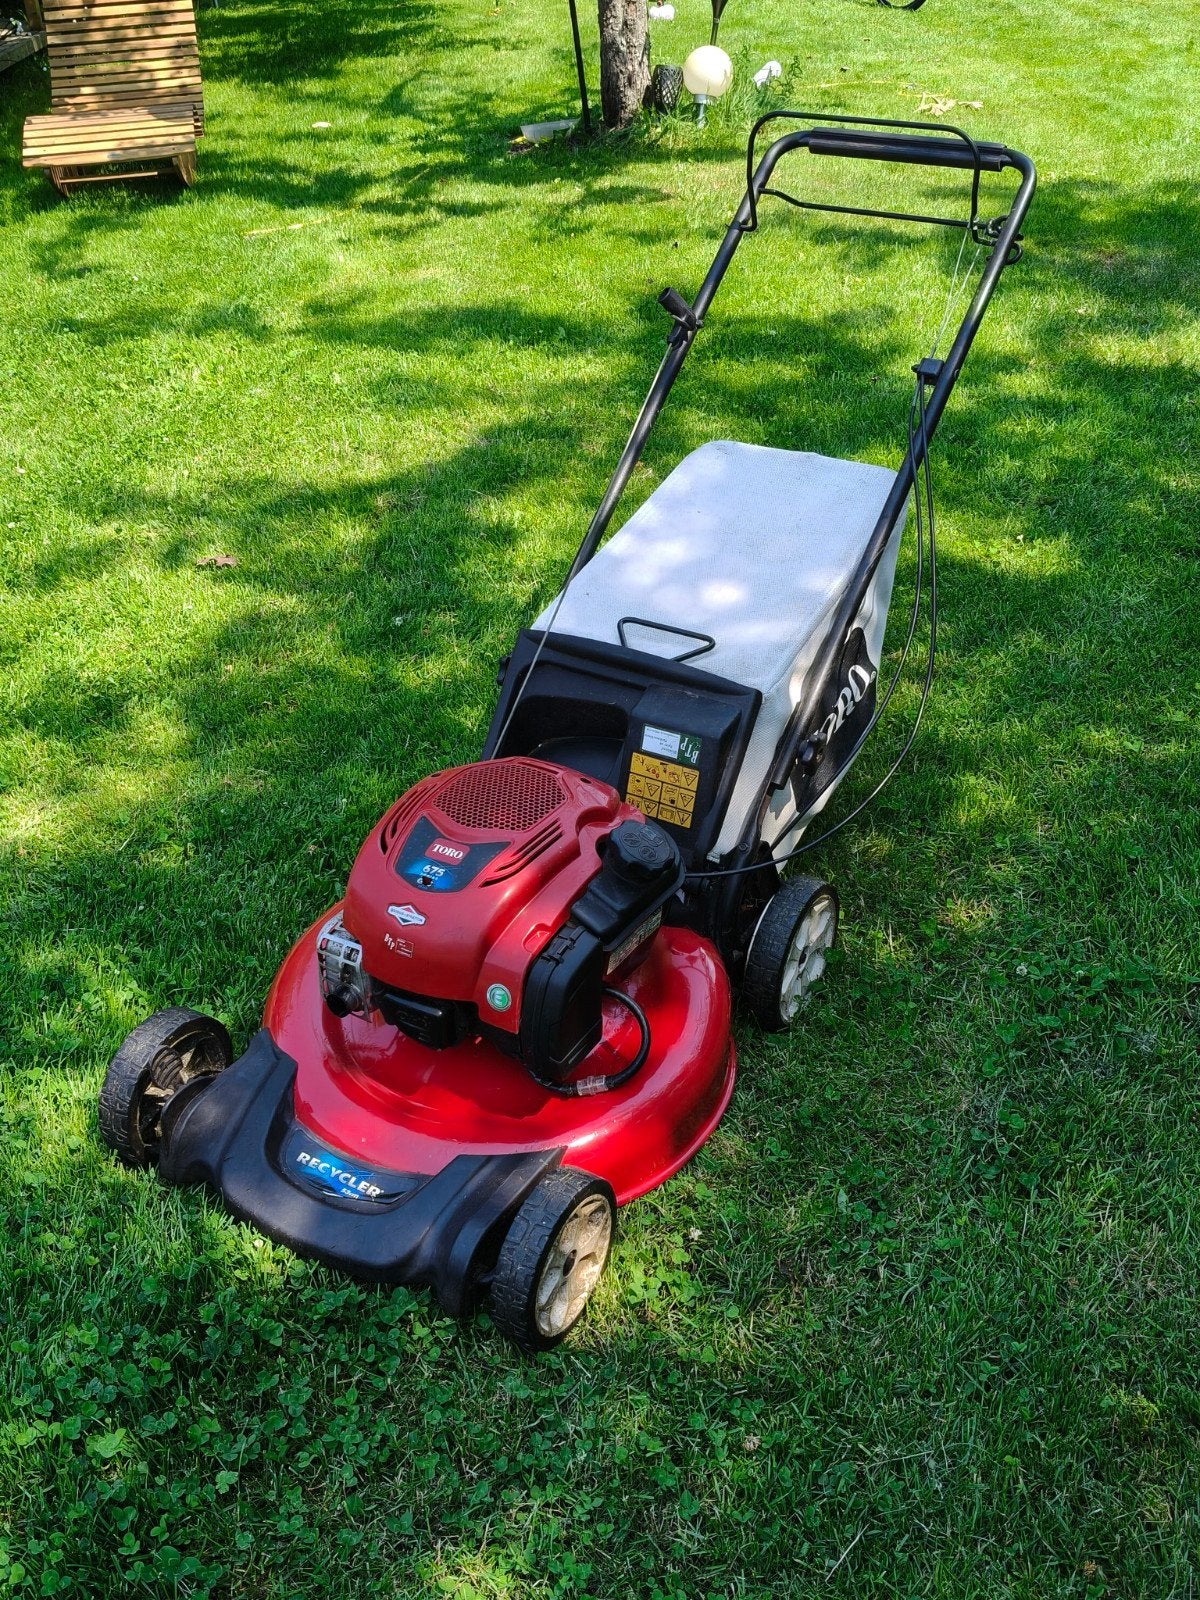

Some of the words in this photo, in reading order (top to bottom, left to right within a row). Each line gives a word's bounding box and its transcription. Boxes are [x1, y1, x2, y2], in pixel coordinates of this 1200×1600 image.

[813, 664, 870, 746] ORO
[432, 844, 464, 859] TORO
[422, 865, 446, 877] 675
[296, 1152, 382, 1198] RECYCLER
